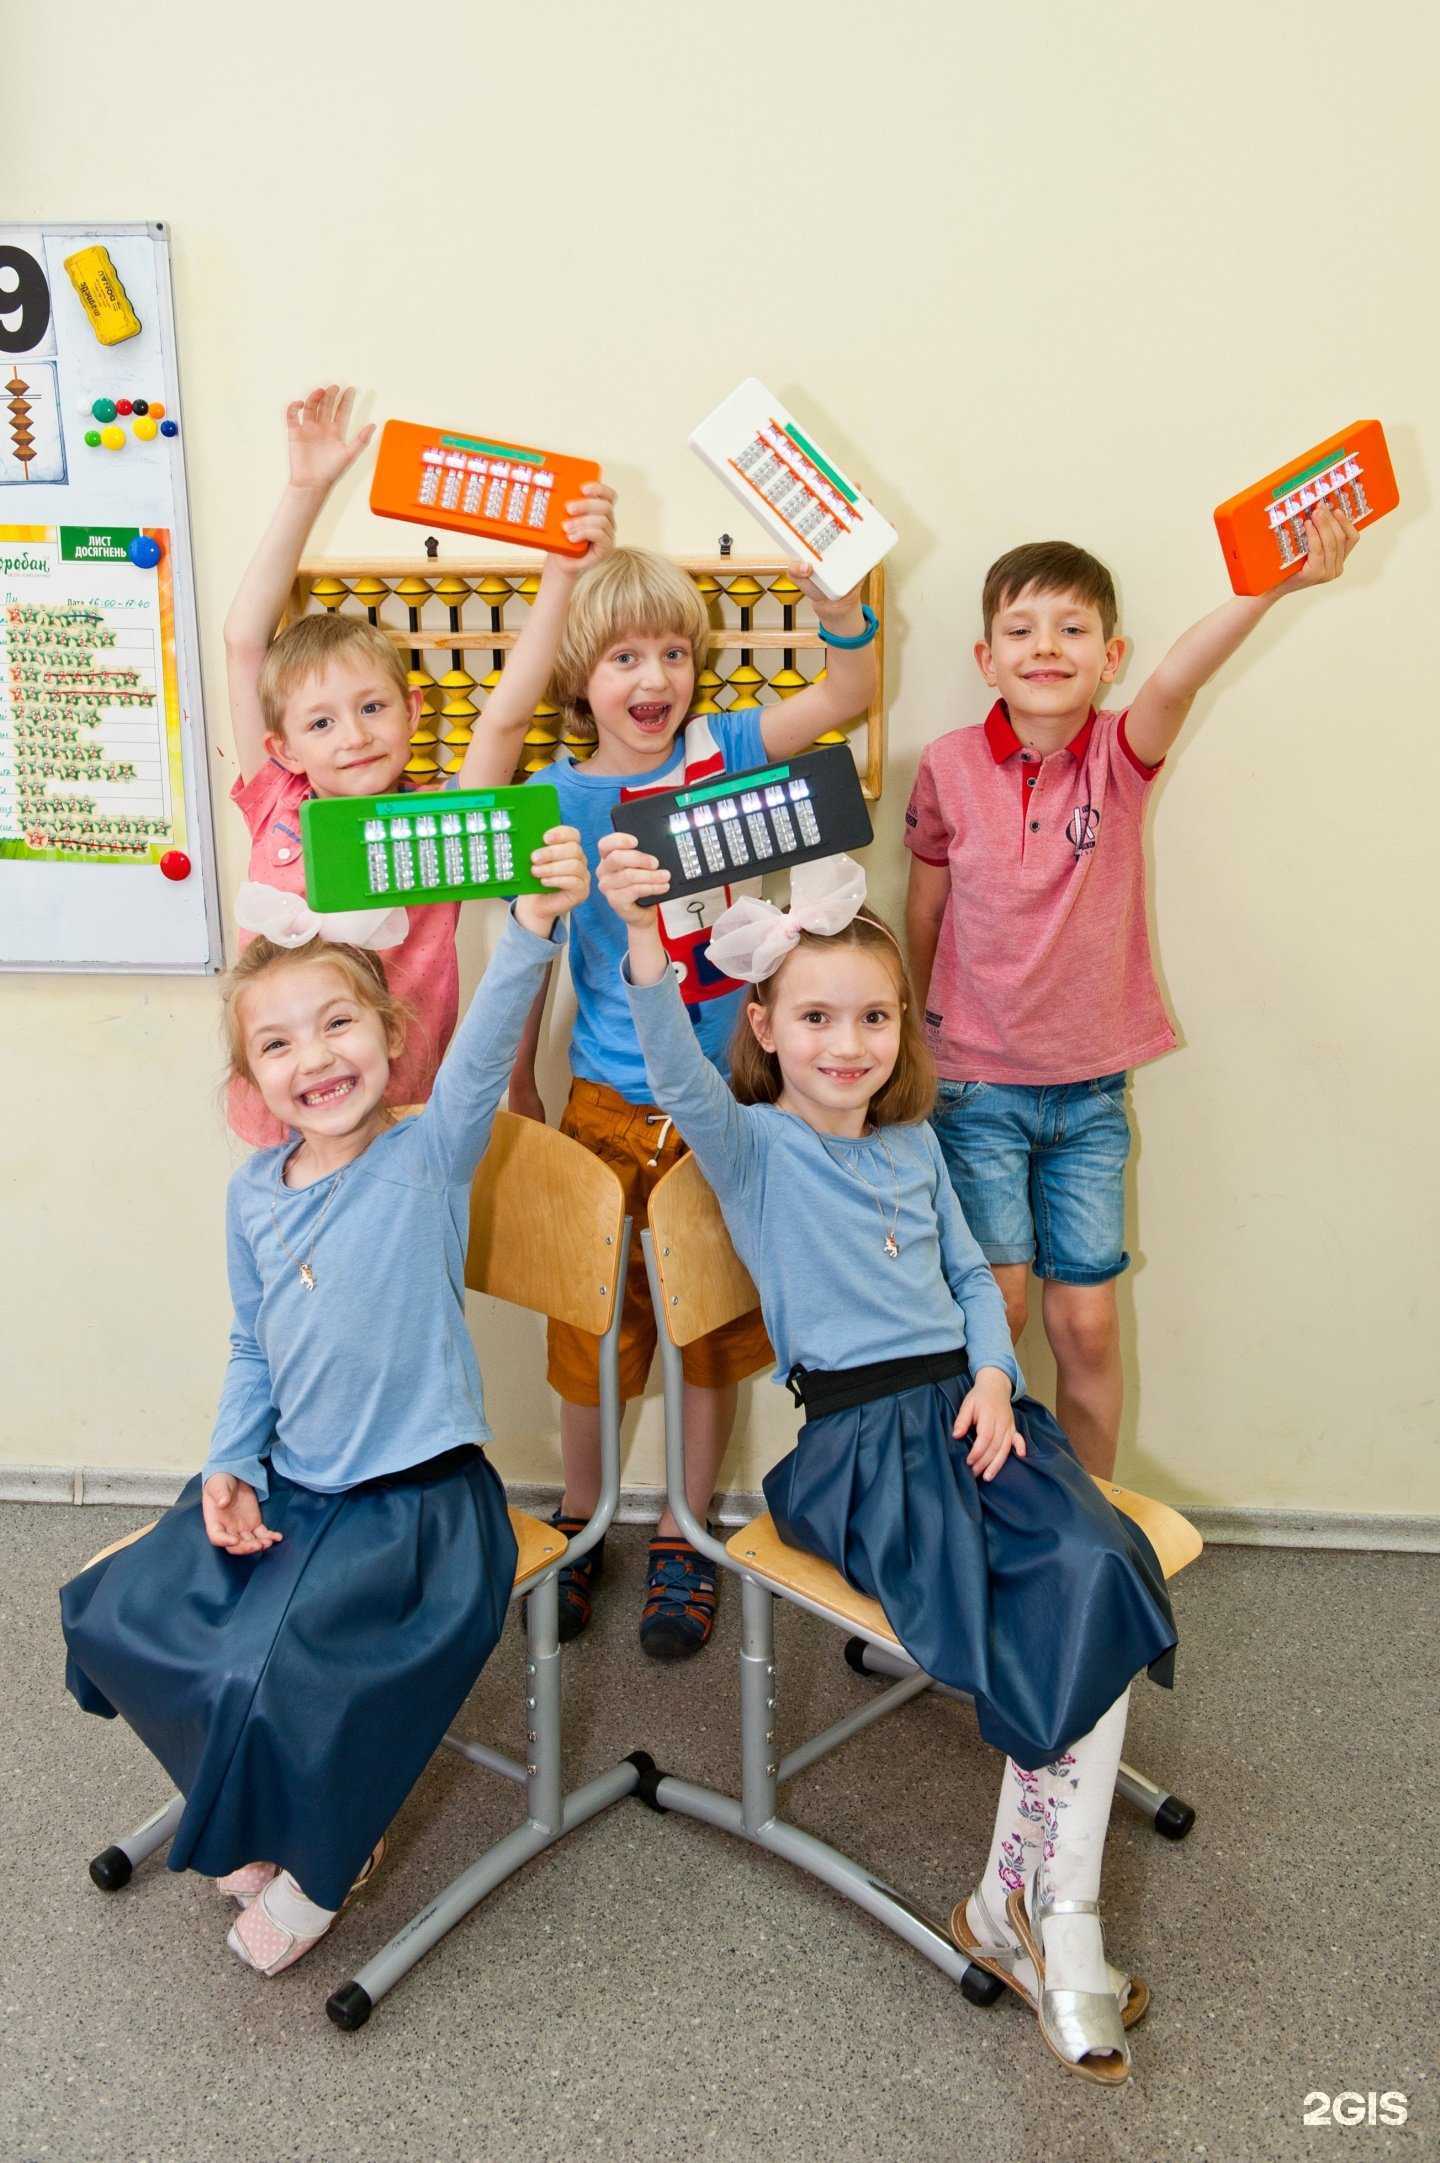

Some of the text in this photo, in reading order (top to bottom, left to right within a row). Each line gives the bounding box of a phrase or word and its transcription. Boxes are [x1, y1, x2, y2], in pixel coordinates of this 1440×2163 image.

[80, 281, 101, 317] magnetic
[88, 535, 112, 547] ЛИСТ
[75, 546, 127, 558] ДОСЯГНЕНЬ
